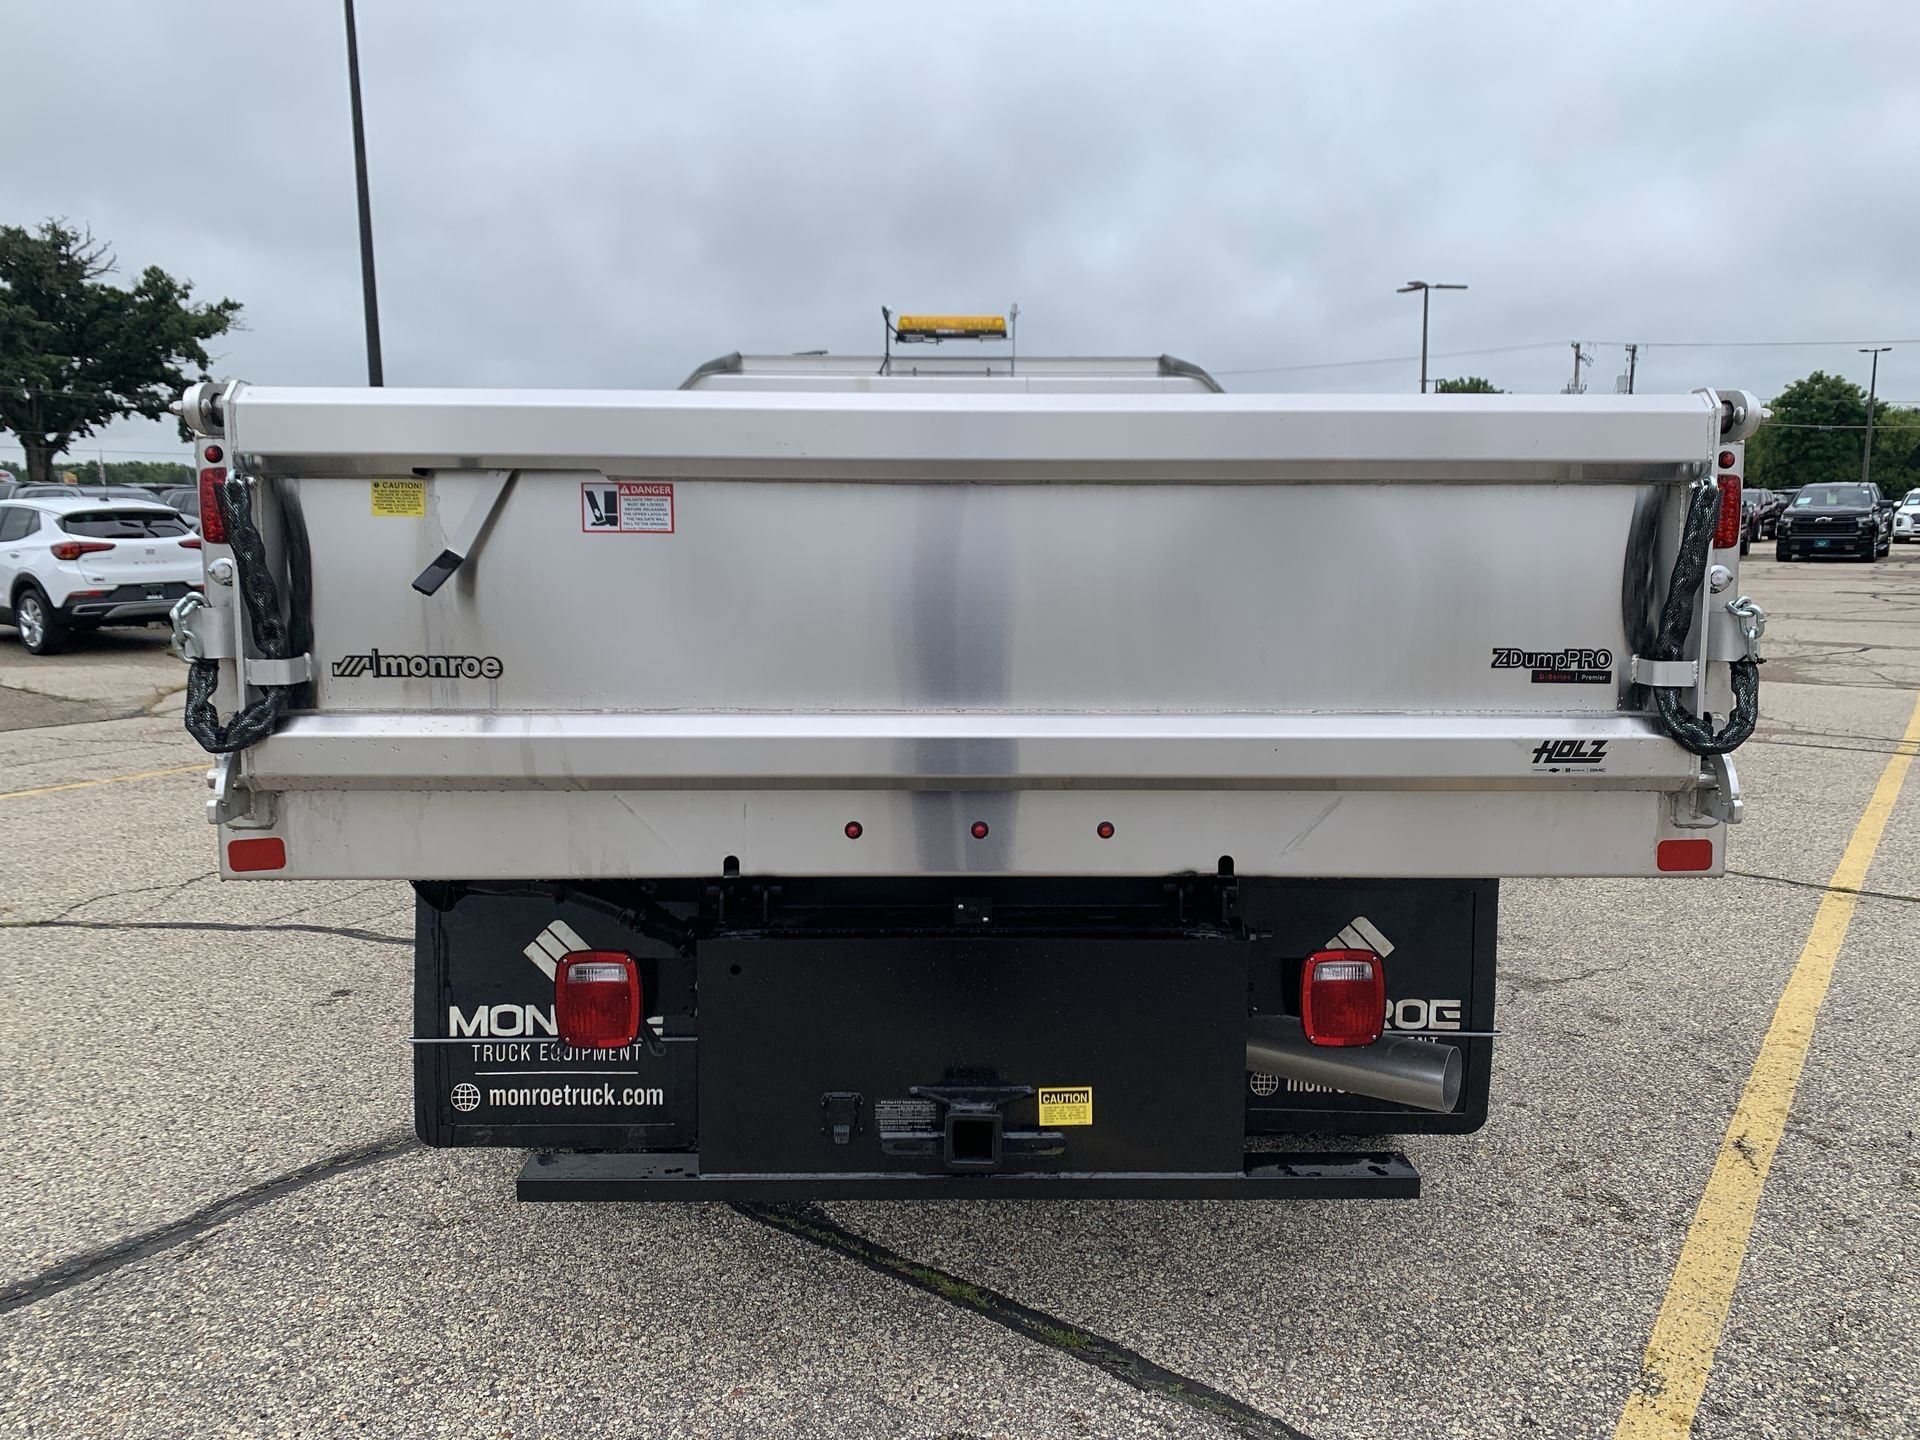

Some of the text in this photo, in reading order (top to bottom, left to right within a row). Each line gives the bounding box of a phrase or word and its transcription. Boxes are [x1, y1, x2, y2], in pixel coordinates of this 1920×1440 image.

[382, 481, 422, 489] CAUTION!
[630, 485, 671, 494] DANGER
[379, 654, 503, 679] monroe
[1491, 648, 1613, 671] ZDumpPRO
[1581, 673, 1607, 681] Premier
[1532, 740, 1608, 764] HOLZ
[471, 1044, 531, 1062] TRUCK
[489, 1083, 664, 1106] monroetruck.com
[1042, 1093, 1088, 1104] CAUTION
